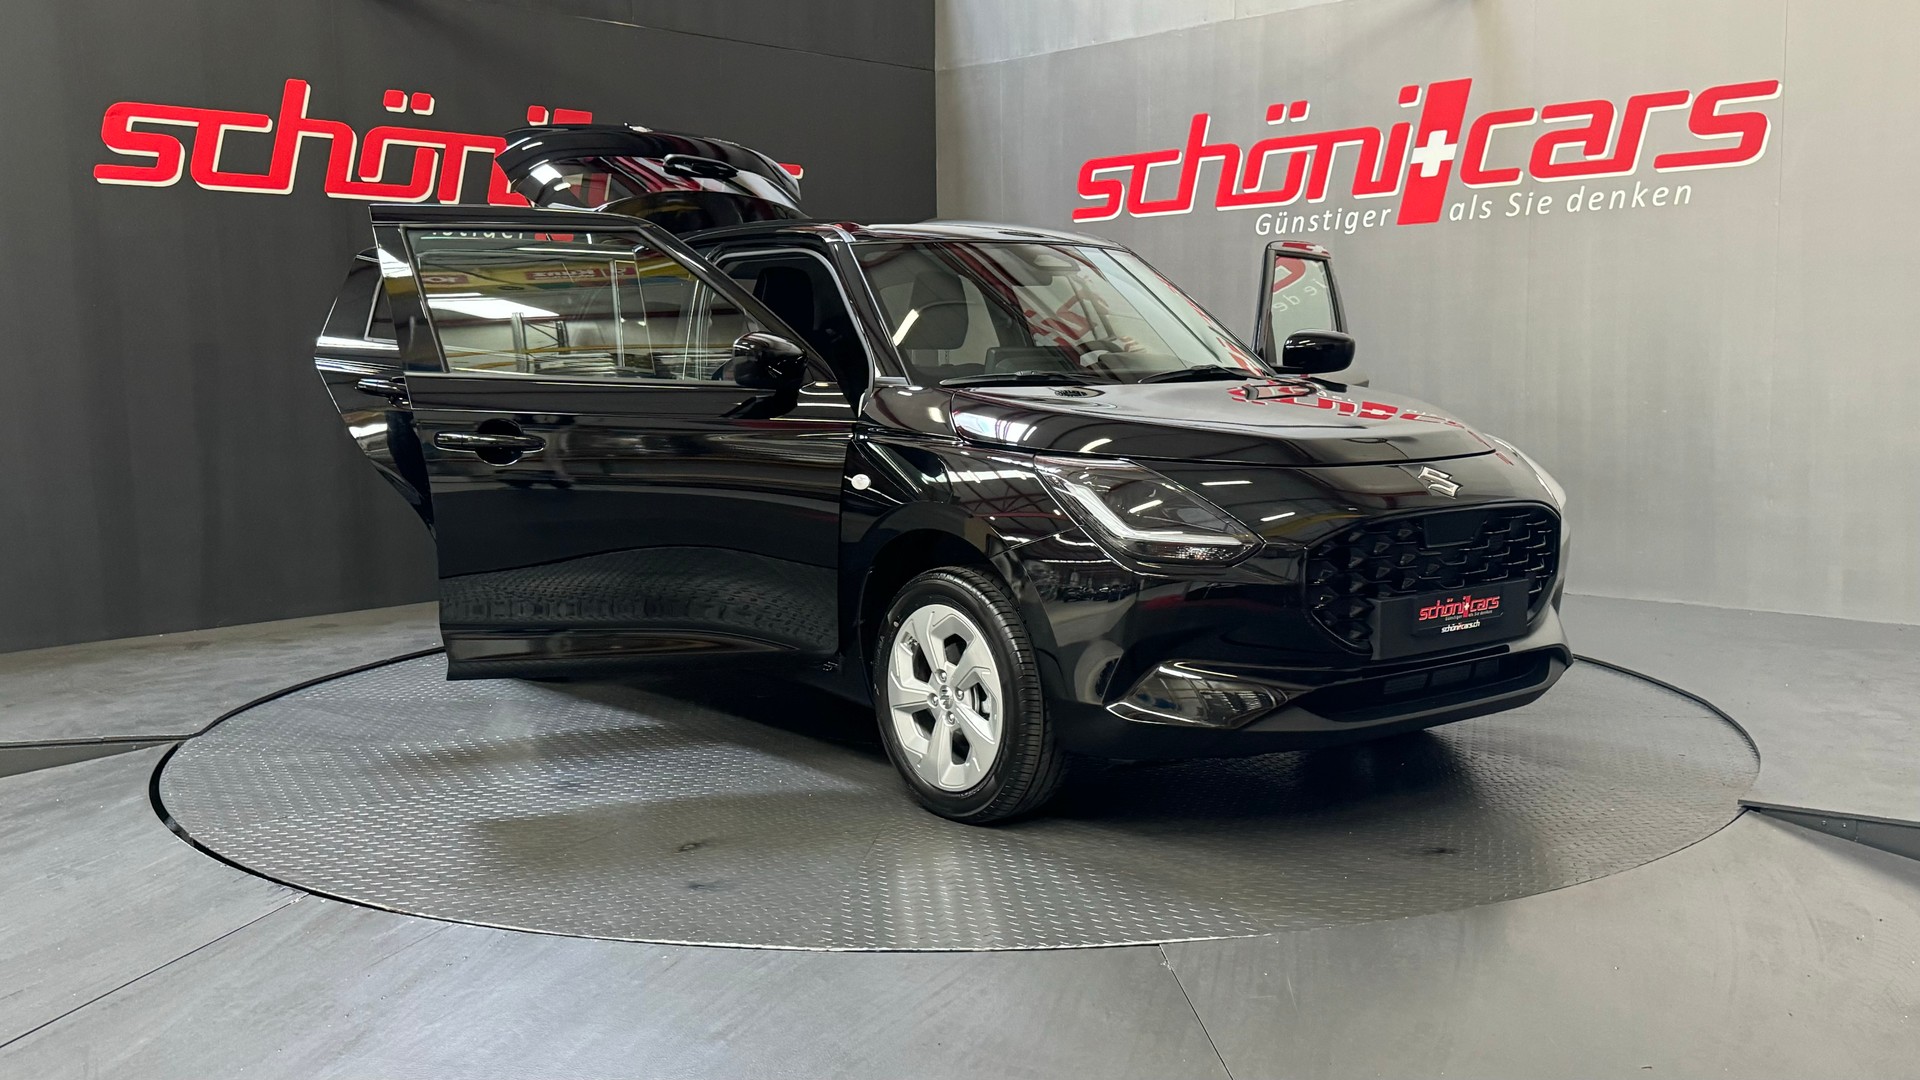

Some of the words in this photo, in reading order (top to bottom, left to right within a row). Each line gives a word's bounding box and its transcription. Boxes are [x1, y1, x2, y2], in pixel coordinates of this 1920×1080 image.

[1255, 207, 1392, 236] Günstiger
[1449, 194, 1493, 222] als
[1505, 191, 1553, 217] Sie
[1566, 181, 1692, 213] denken
